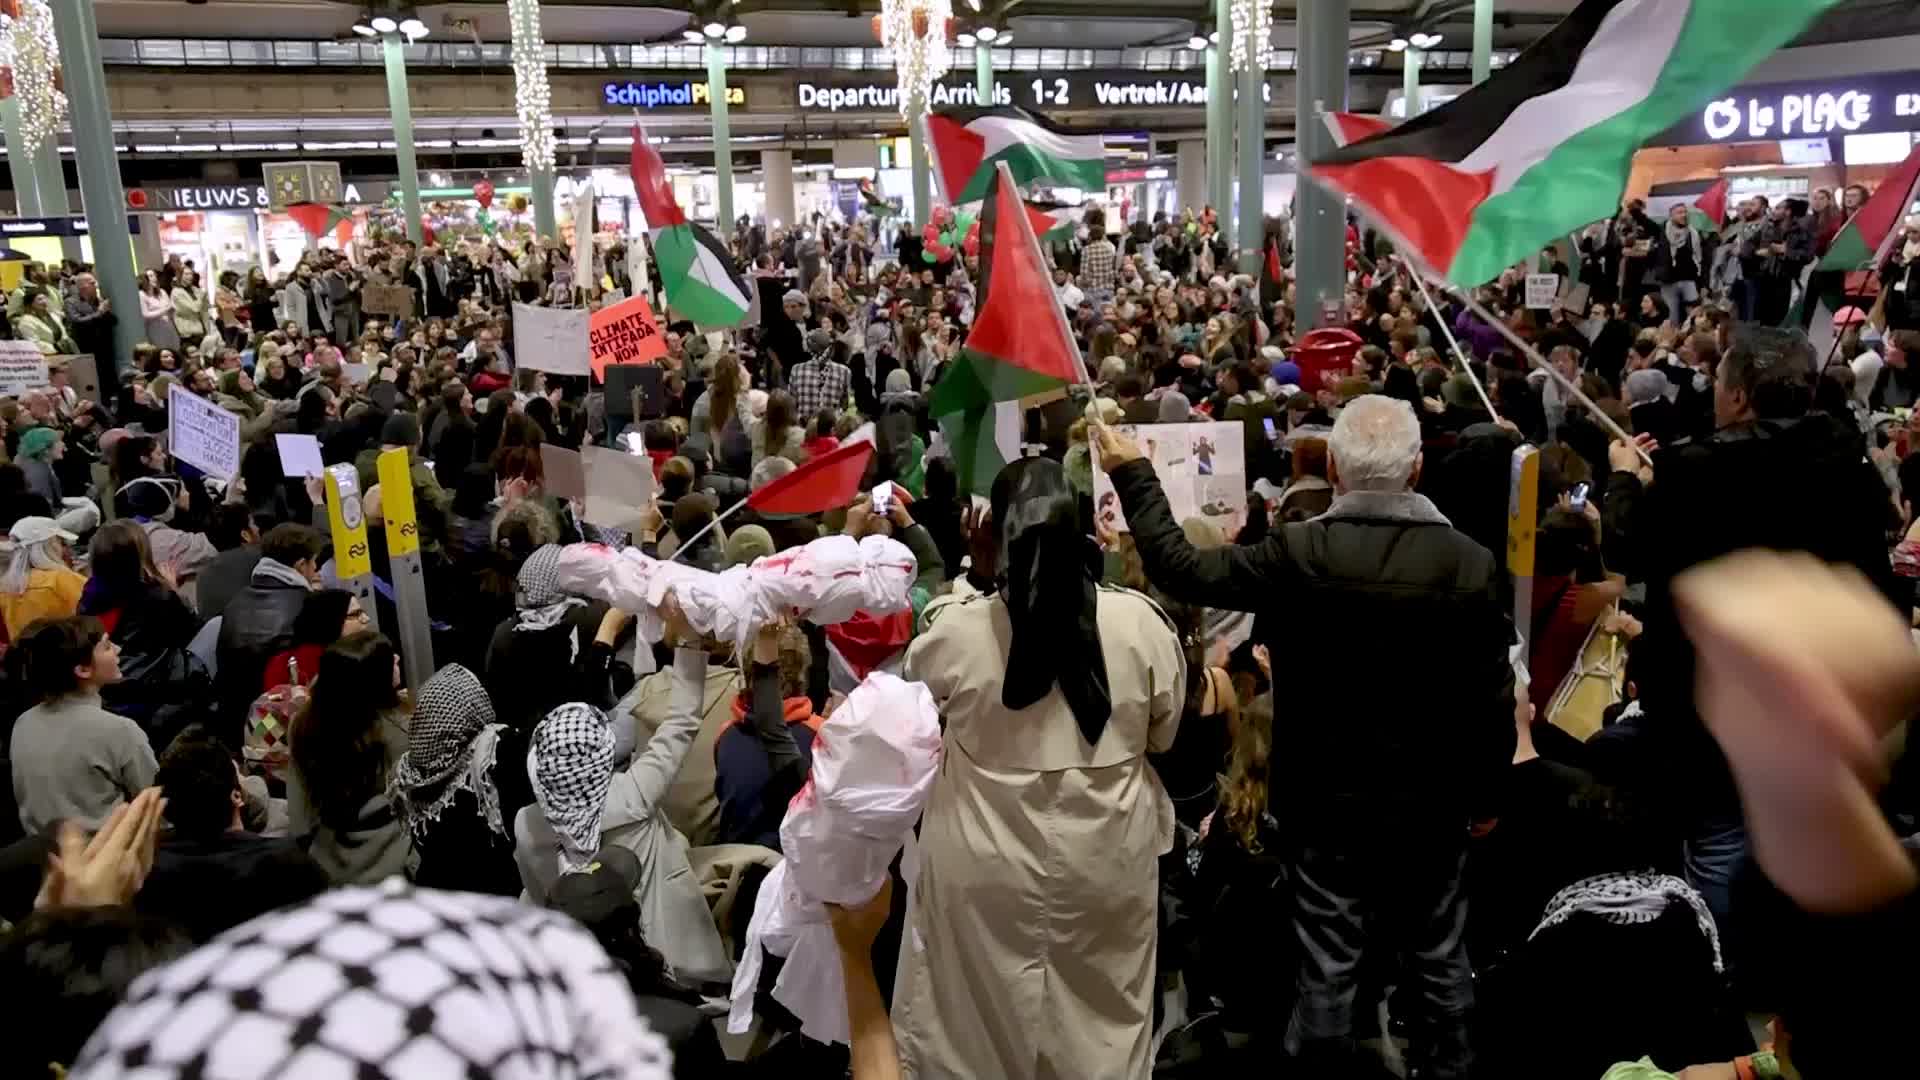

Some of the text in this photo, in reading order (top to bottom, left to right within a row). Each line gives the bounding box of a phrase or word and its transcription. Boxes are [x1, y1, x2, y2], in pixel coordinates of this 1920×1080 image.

[1031, 78, 1070, 104] 1-2
[1781, 90, 1872, 135] PLACE
[155, 186, 270, 208] NIEUWS &
[590, 312, 644, 344] CLIMATE
[591, 323, 655, 359] INTIFADA
[613, 343, 640, 364] NOW
